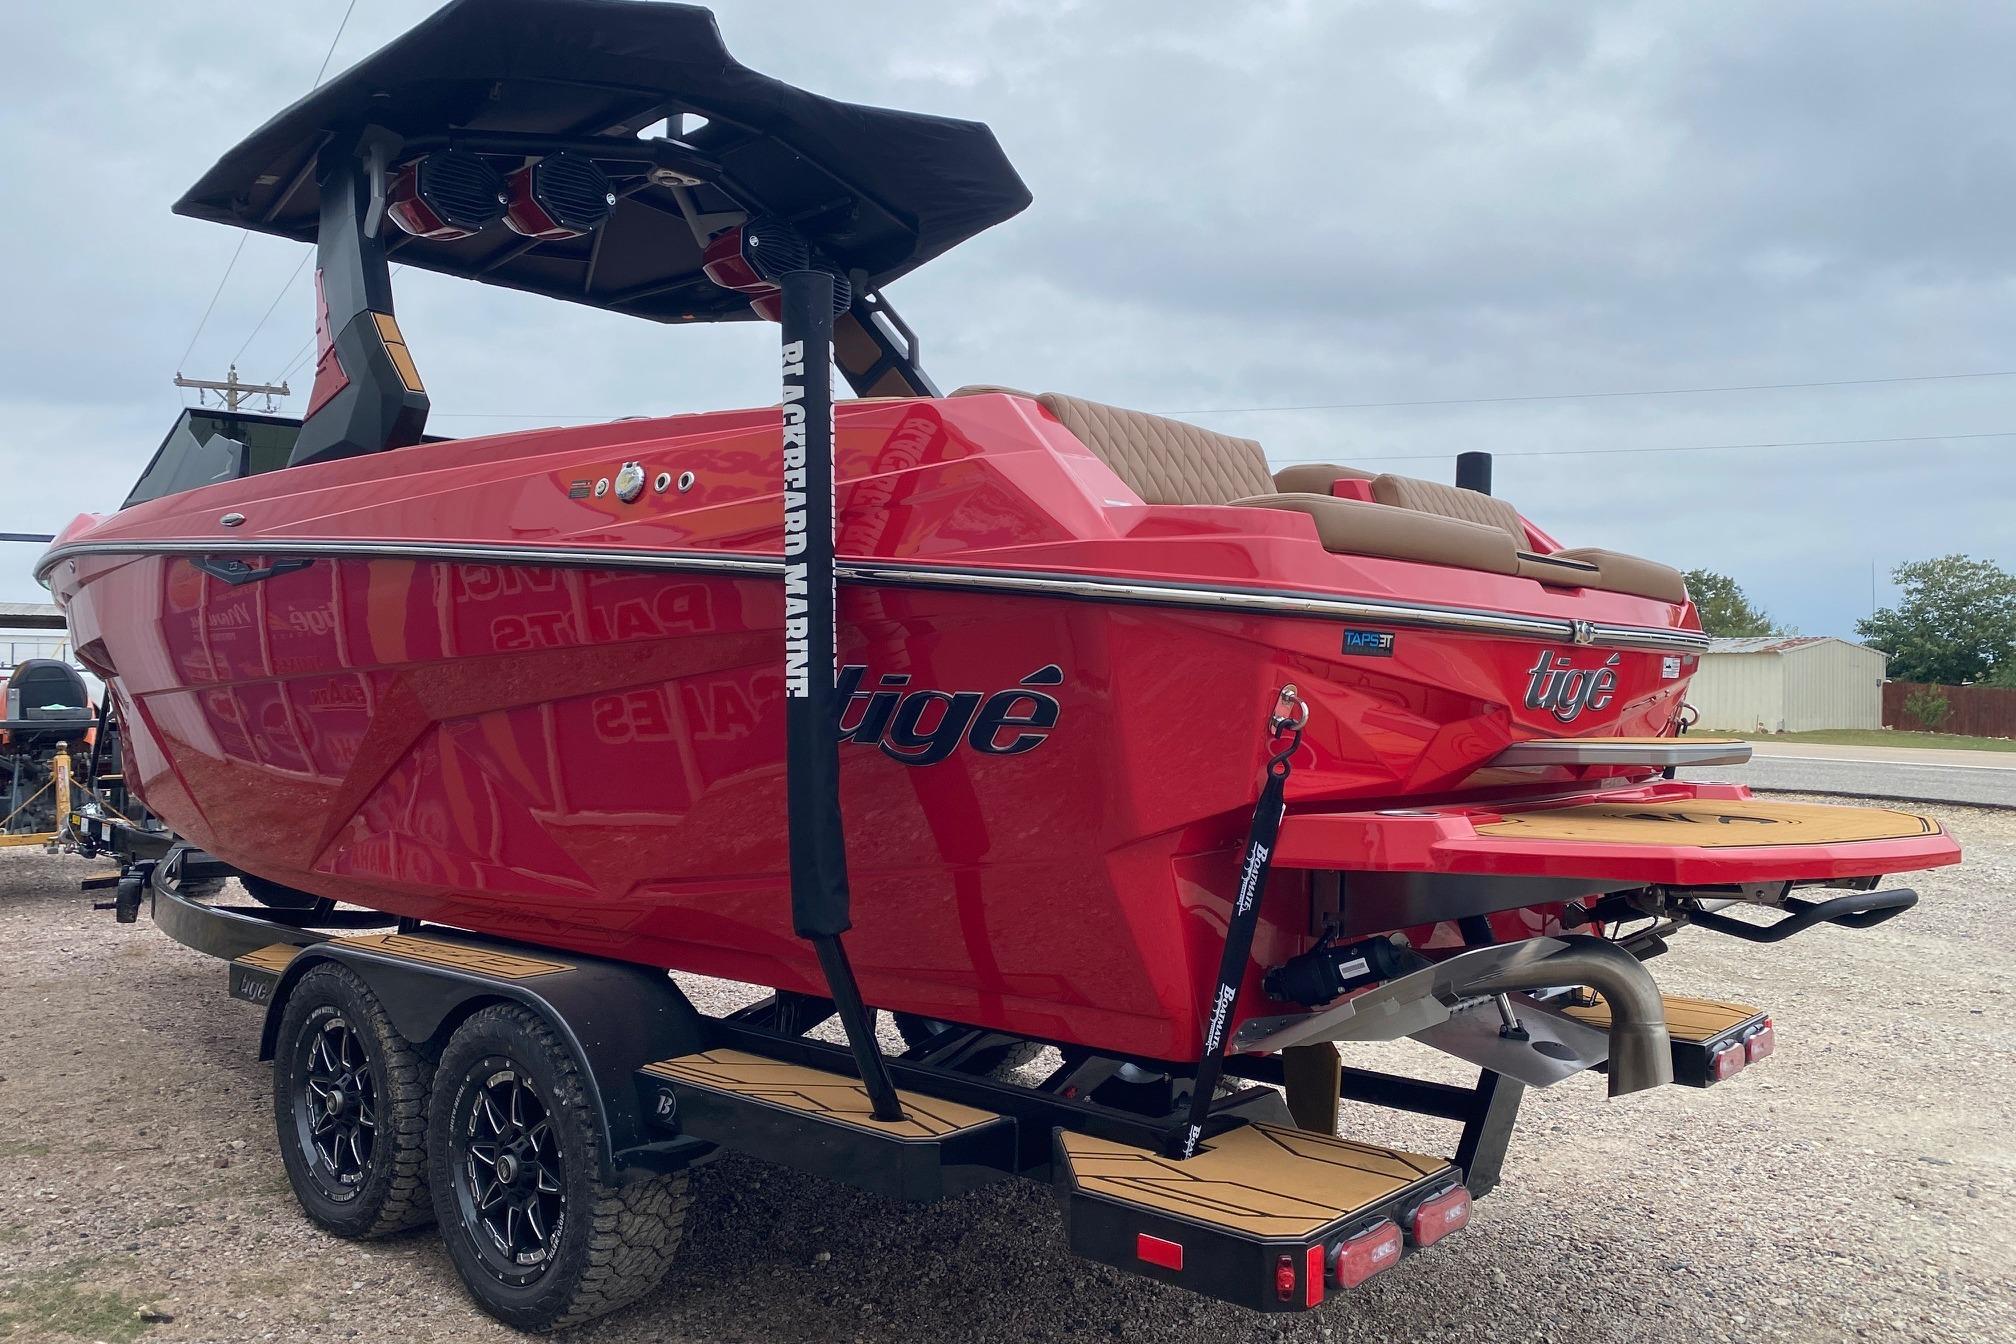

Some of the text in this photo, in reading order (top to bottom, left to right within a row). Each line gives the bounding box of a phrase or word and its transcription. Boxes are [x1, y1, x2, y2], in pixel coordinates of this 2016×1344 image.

[782, 340, 809, 698] BLACKBEARD MARINE
[834, 664, 1064, 766] tigé
[1524, 650, 1621, 723] tigé
[1241, 843, 1269, 911] BOATMATE
[1211, 985, 1236, 1050] BOATMATE
[1187, 1124, 1201, 1160] BOA
